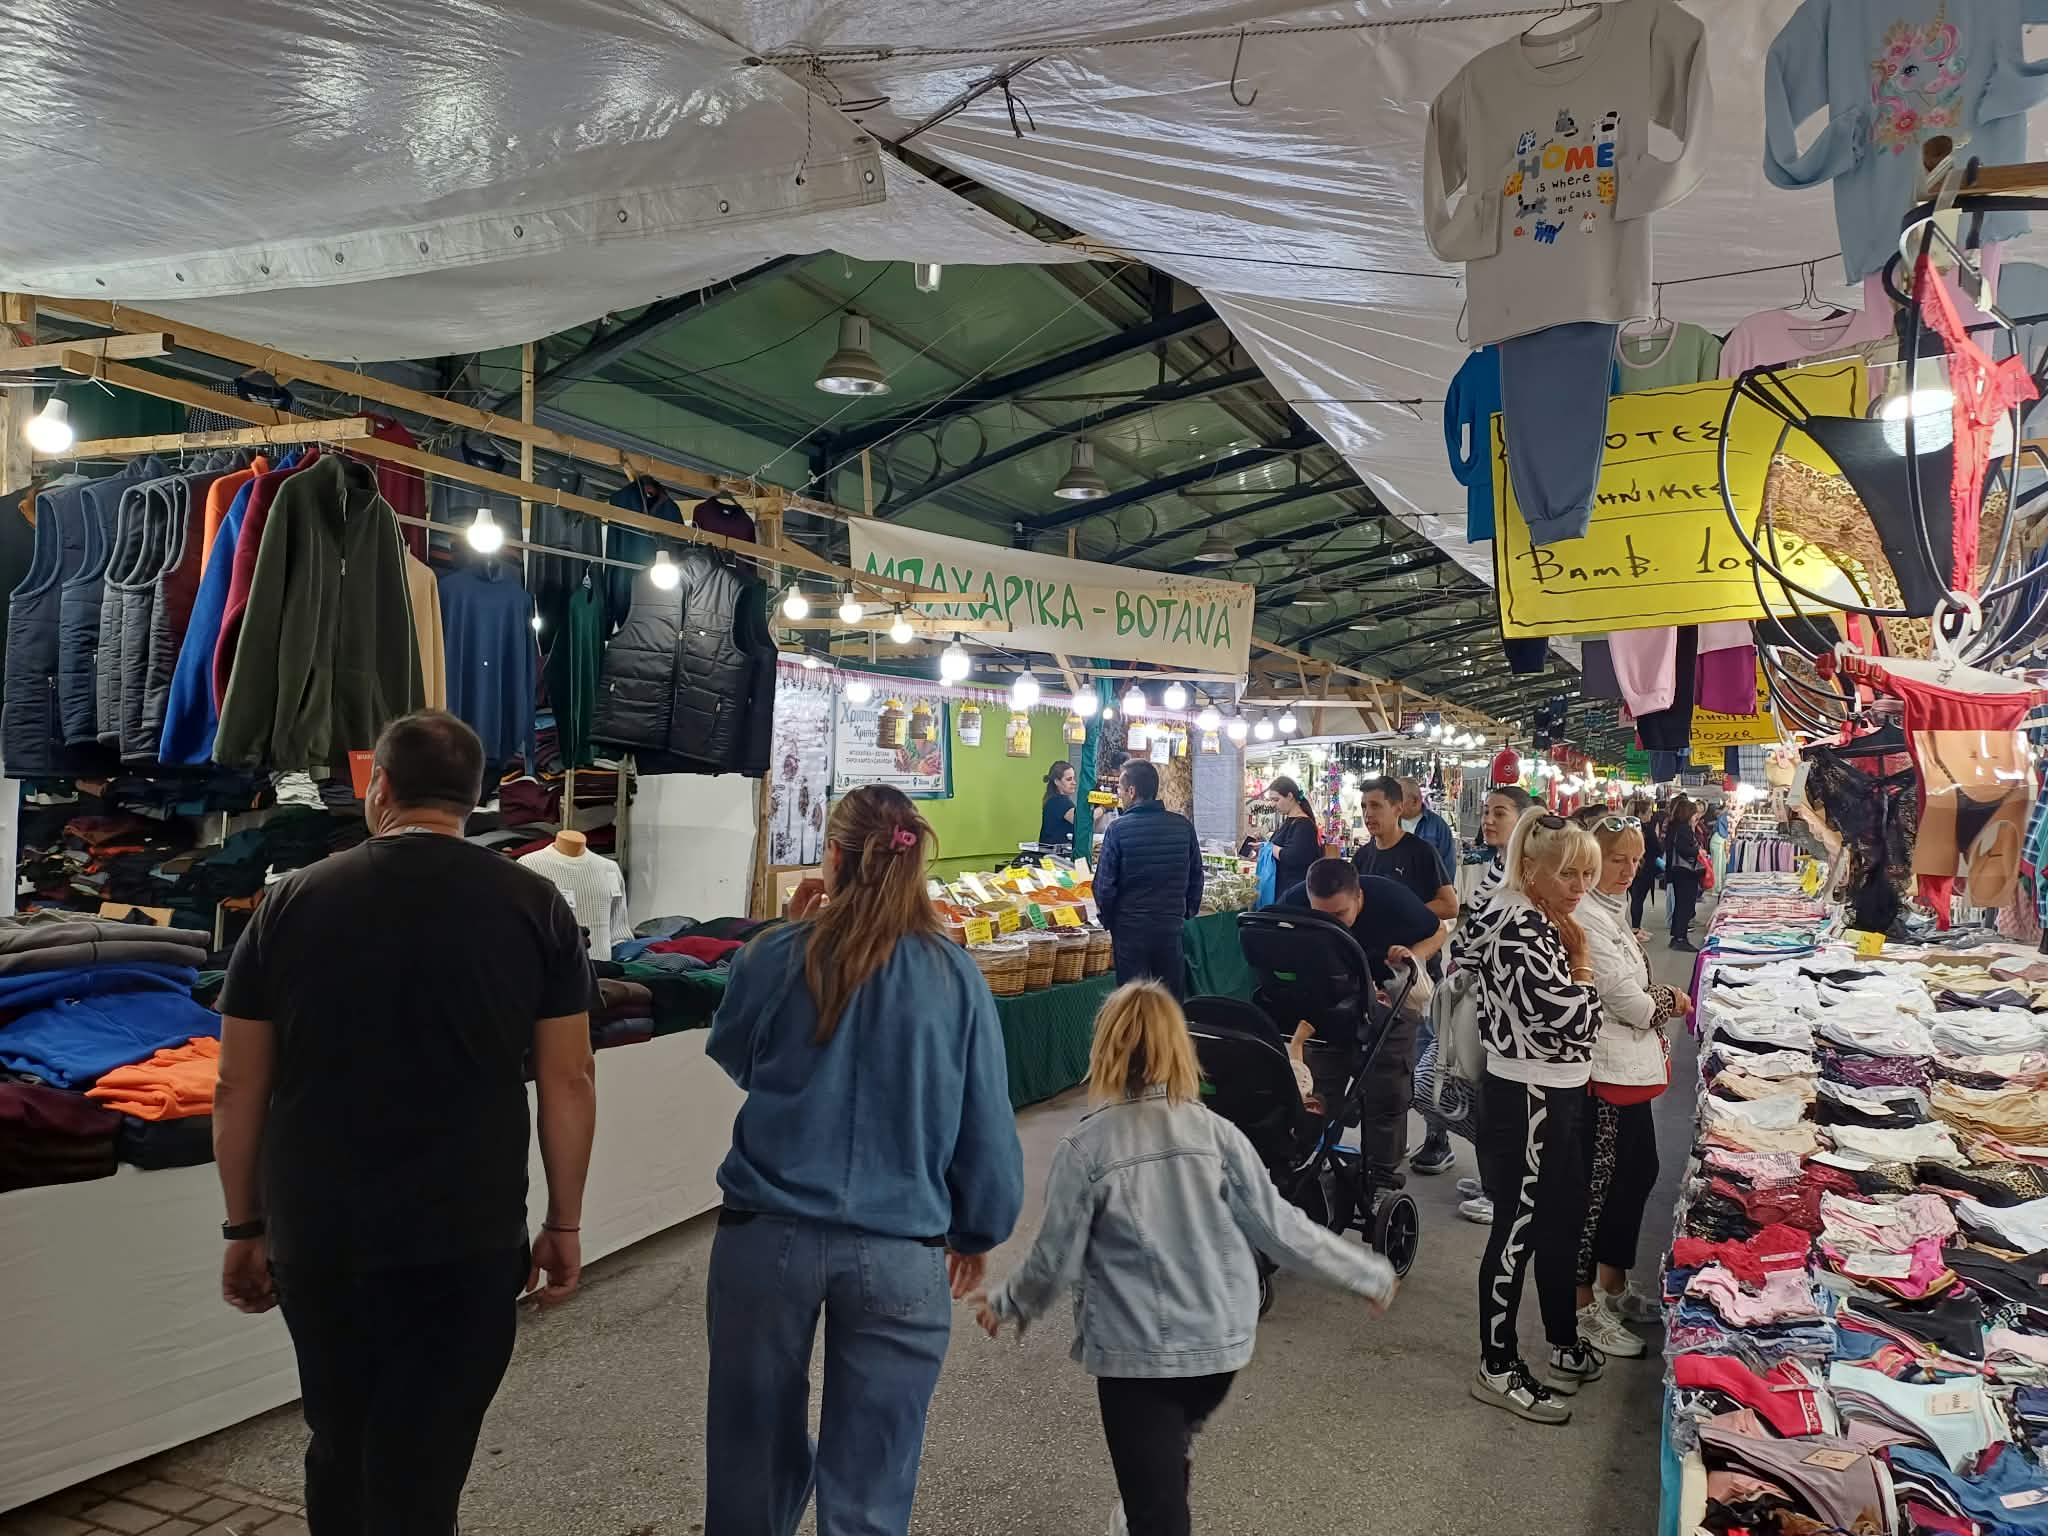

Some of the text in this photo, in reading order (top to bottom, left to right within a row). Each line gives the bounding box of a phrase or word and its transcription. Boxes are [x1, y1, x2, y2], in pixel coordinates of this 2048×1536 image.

[1518, 143, 1614, 178] HOME
[1536, 173, 1591, 193] is where
[1558, 205, 1574, 215] are
[1115, 590, 1231, 648] ΒΟΤΑΝΑ
